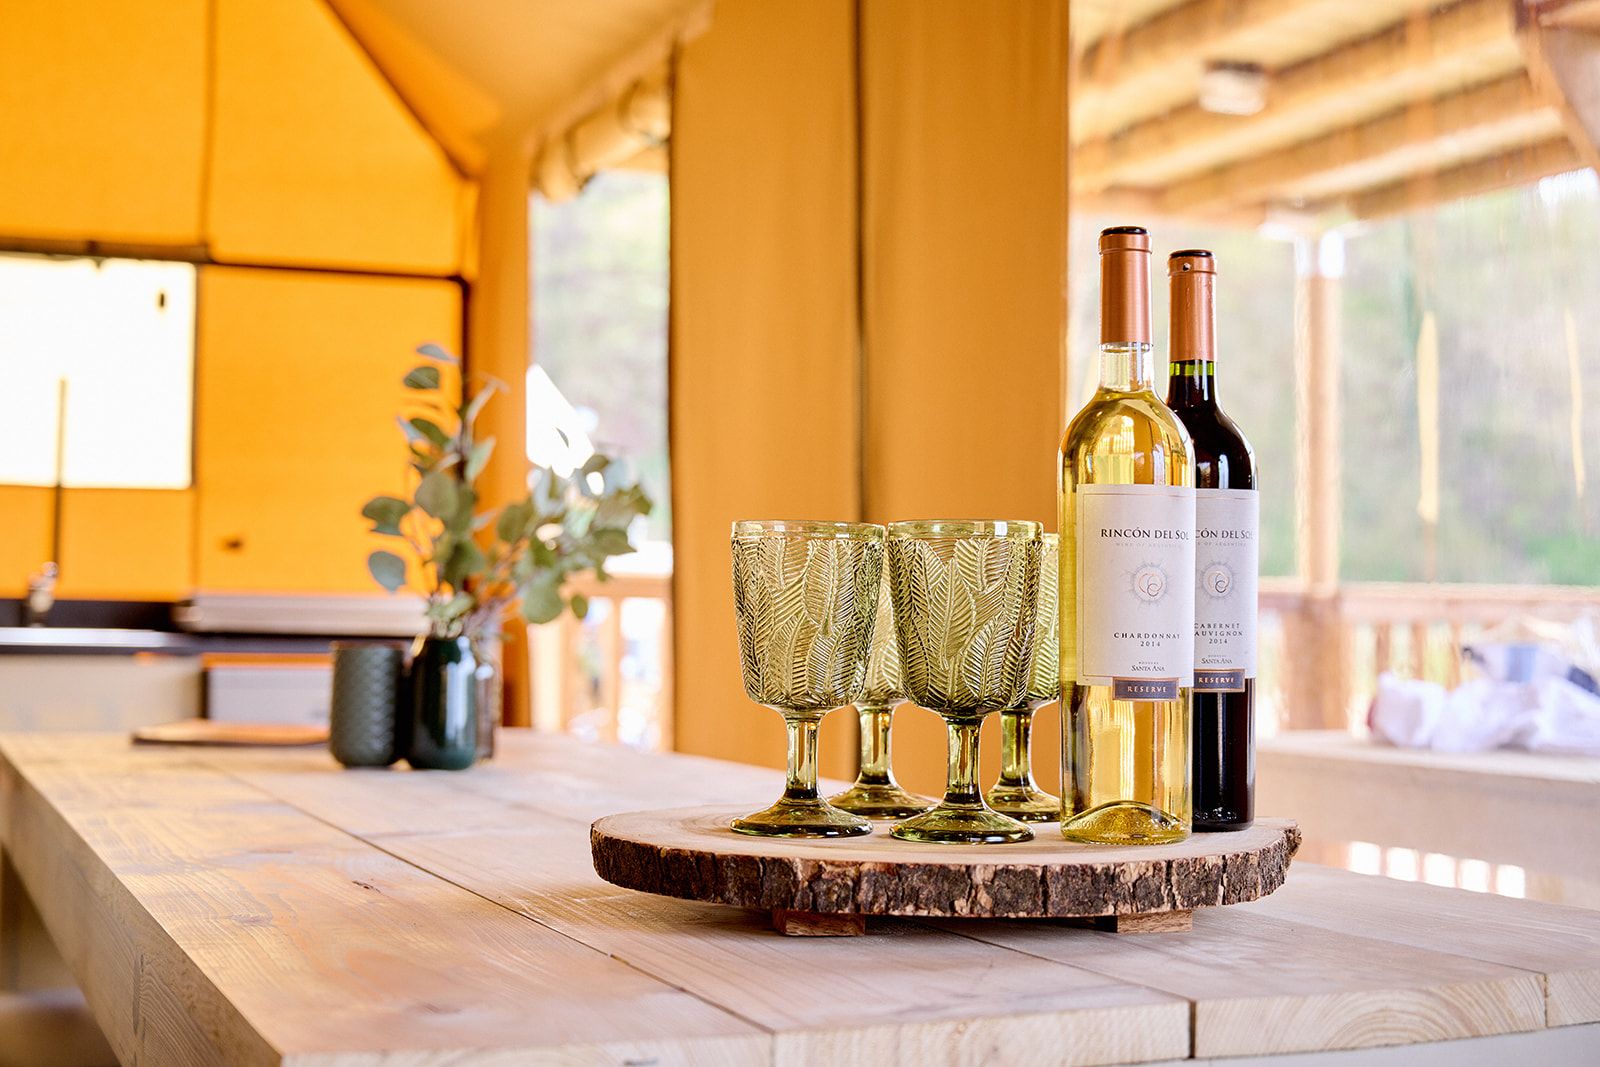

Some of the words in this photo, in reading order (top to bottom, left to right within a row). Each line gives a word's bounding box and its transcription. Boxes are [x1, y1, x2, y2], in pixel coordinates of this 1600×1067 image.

[1101, 527, 1151, 538] RINCÓN
[1154, 529, 1174, 540] DEL
[1221, 529, 1239, 539] DEL
[1198, 676, 1235, 684] RESERVE
[1127, 685, 1168, 693] RESERVE
